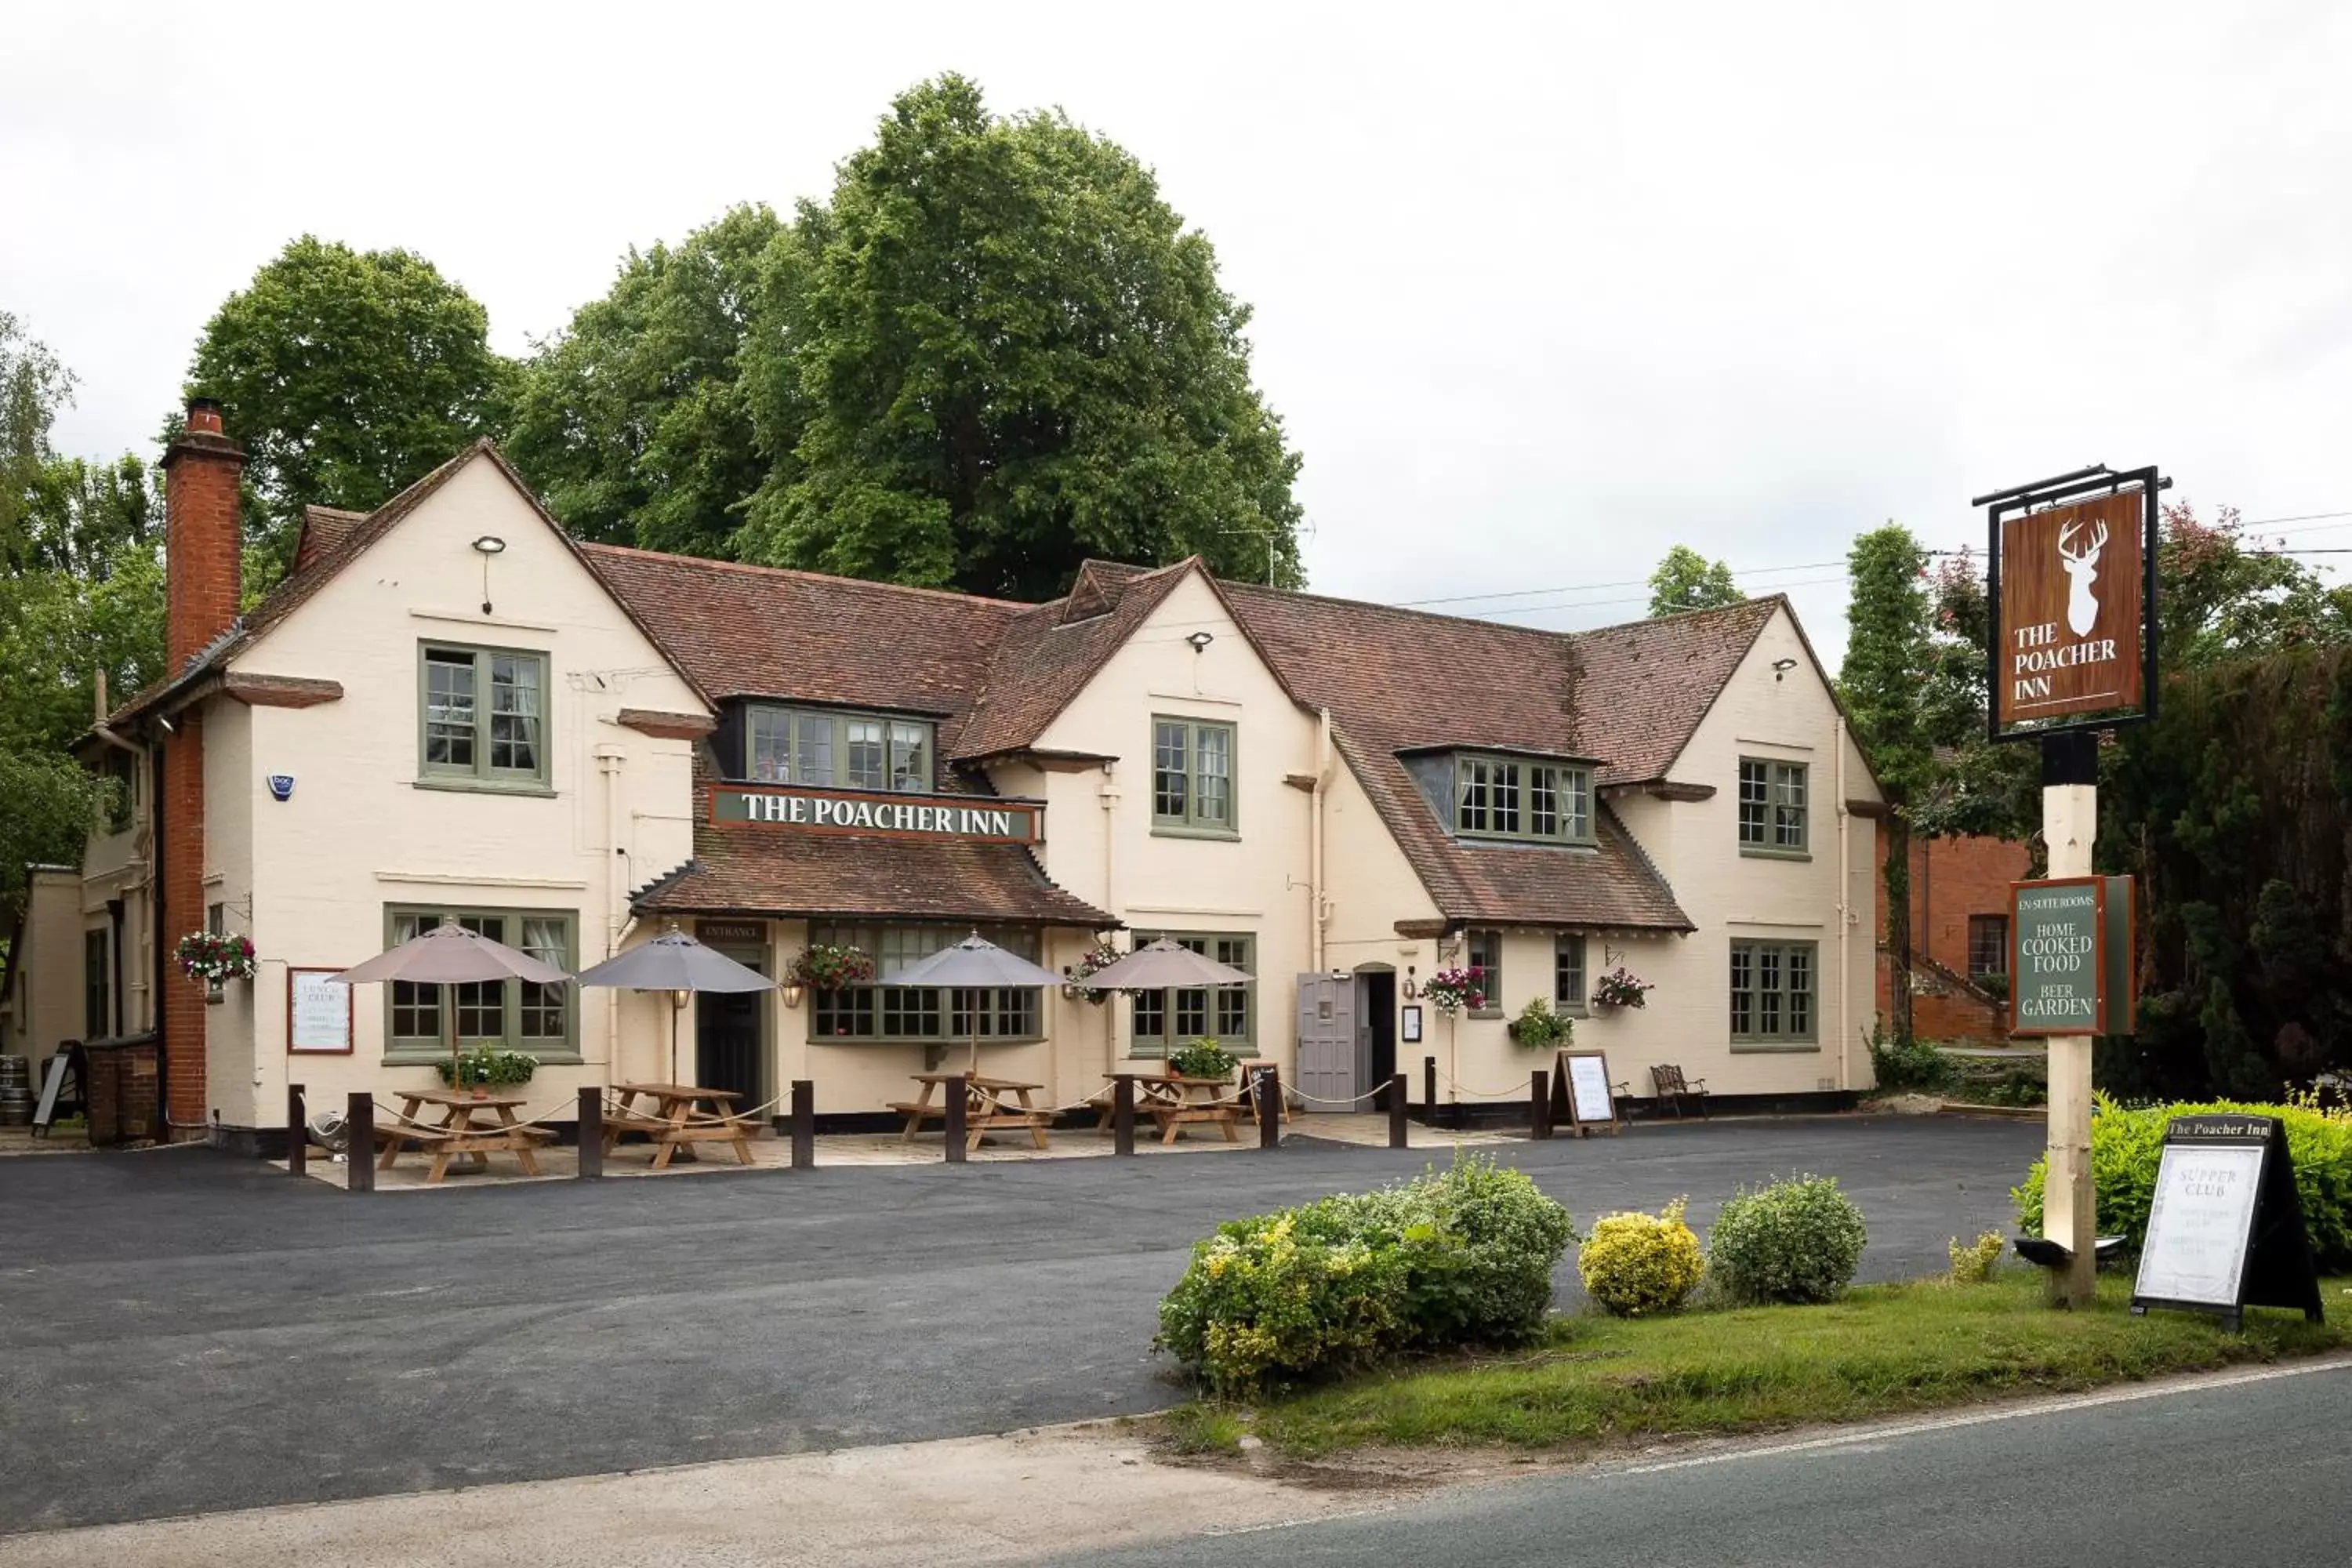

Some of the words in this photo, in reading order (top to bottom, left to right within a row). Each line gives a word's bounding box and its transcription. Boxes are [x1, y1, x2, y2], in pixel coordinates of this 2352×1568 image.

[2015, 623, 2058, 648] THE
[2016, 639, 2117, 674] POACHER
[2015, 675, 2052, 700] INN
[741, 793, 807, 823] THE
[814, 799, 953, 833] POACHER
[960, 808, 1011, 837] INN
[706, 927, 757, 937] ENTRANCE
[2038, 923, 2077, 938] HOME
[2022, 936, 2092, 956] COOKED
[2034, 955, 2081, 972] FOOD
[2041, 985, 2074, 998] BEER
[2022, 998, 2092, 1016] GARDEN
[2169, 1123, 2192, 1134] The
[2194, 1123, 2244, 1134] Poacher
[2246, 1123, 2269, 1135] Inn
[2180, 1168, 2236, 1182] SUPPER
[2184, 1183, 2225, 1196] CLUB
